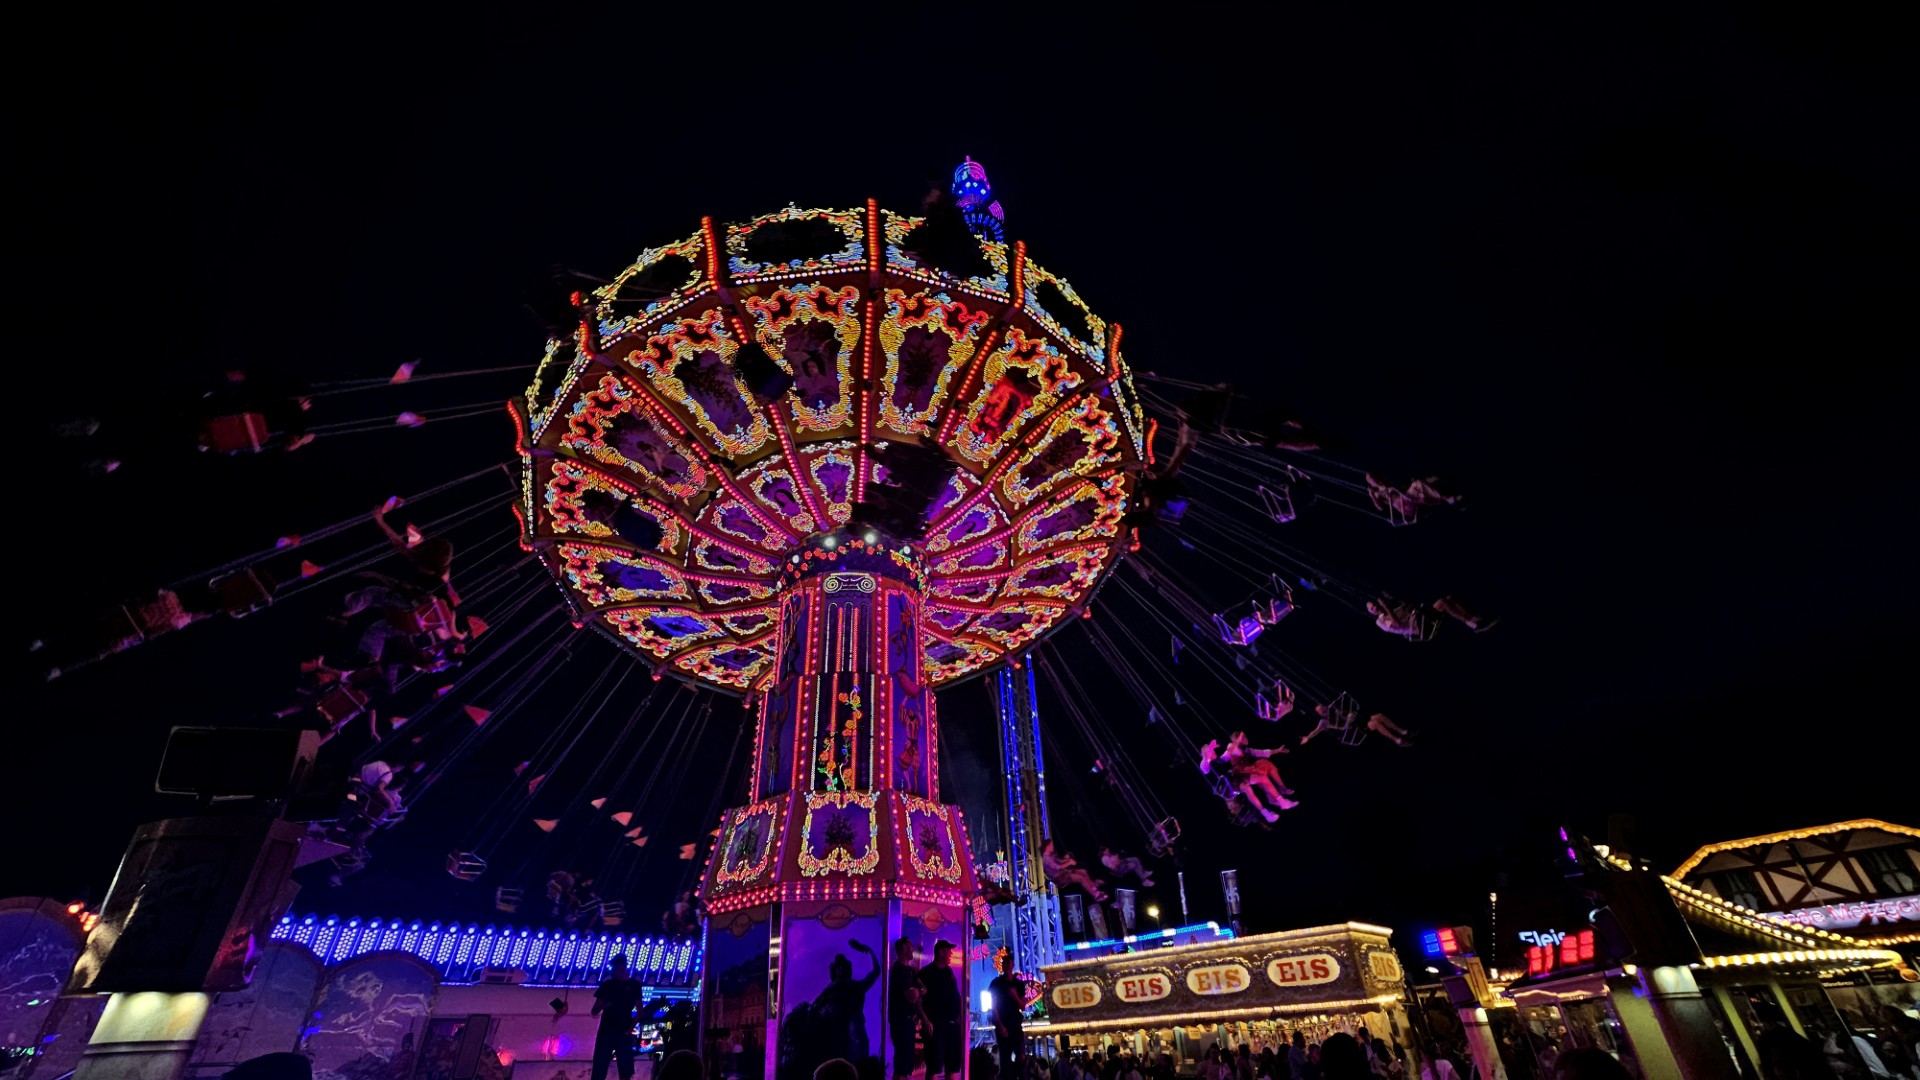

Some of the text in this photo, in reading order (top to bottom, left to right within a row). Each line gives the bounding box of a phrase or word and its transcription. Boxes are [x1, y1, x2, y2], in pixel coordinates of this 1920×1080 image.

[1276, 958, 1330, 983] EIS
[1371, 955, 1397, 977] EIS
[1122, 977, 1164, 999] EIS
[1194, 968, 1242, 993] EIS
[1058, 985, 1095, 1006] EIS
